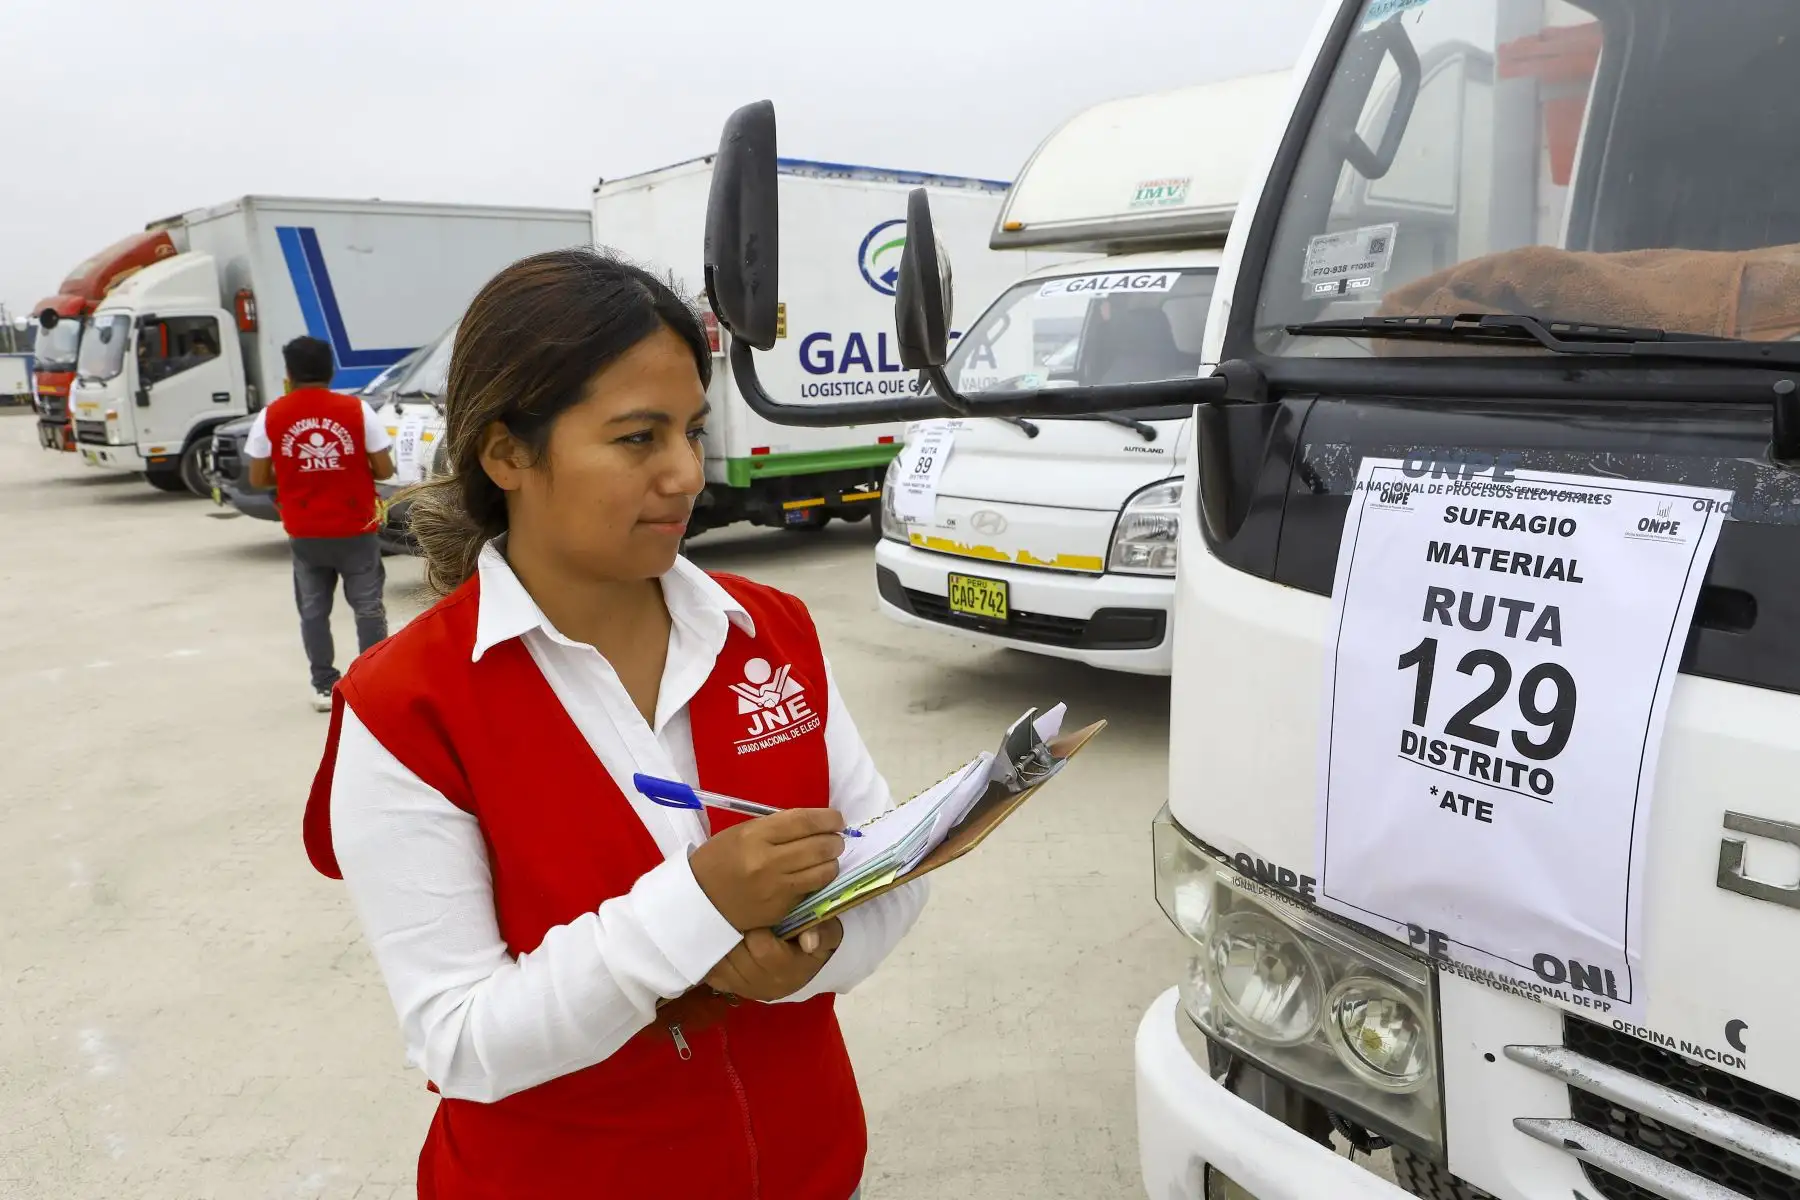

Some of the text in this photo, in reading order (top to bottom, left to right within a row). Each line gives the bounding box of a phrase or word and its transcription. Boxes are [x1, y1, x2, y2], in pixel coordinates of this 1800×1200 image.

[1066, 275, 1168, 292] GALAGA
[799, 331, 998, 375] GALA
[801, 381, 874, 398] LOGISTICA
[878, 379, 904, 394] QUE
[301, 457, 340, 469] JNE
[914, 457, 932, 473] 89
[1123, 446, 1164, 454] AUTOLAND
[1403, 451, 1521, 483] ONPE
[1366, 481, 1425, 495] NACIONAL
[1428, 484, 1443, 495] DE
[1380, 491, 1411, 505] ONPE
[1443, 506, 1578, 538] SUFRAGIO
[1637, 517, 1681, 535] ONPE
[1426, 541, 1584, 584] MATERIAL
[967, 578, 988, 588] PERU
[952, 584, 1004, 614] CAQ-742
[1422, 586, 1563, 647] RUTA
[1397, 637, 1578, 761] 129
[747, 694, 812, 736] JNE
[737, 743, 760, 755] JURADO
[760, 733, 791, 750] NACIONAL
[790, 728, 801, 738] DE
[1400, 730, 1555, 796] DISTRITO
[1499, 973, 1570, 1003] NACIONAL
[1572, 994, 1591, 1008] DE
[1612, 1019, 1677, 1049] OFICINA
